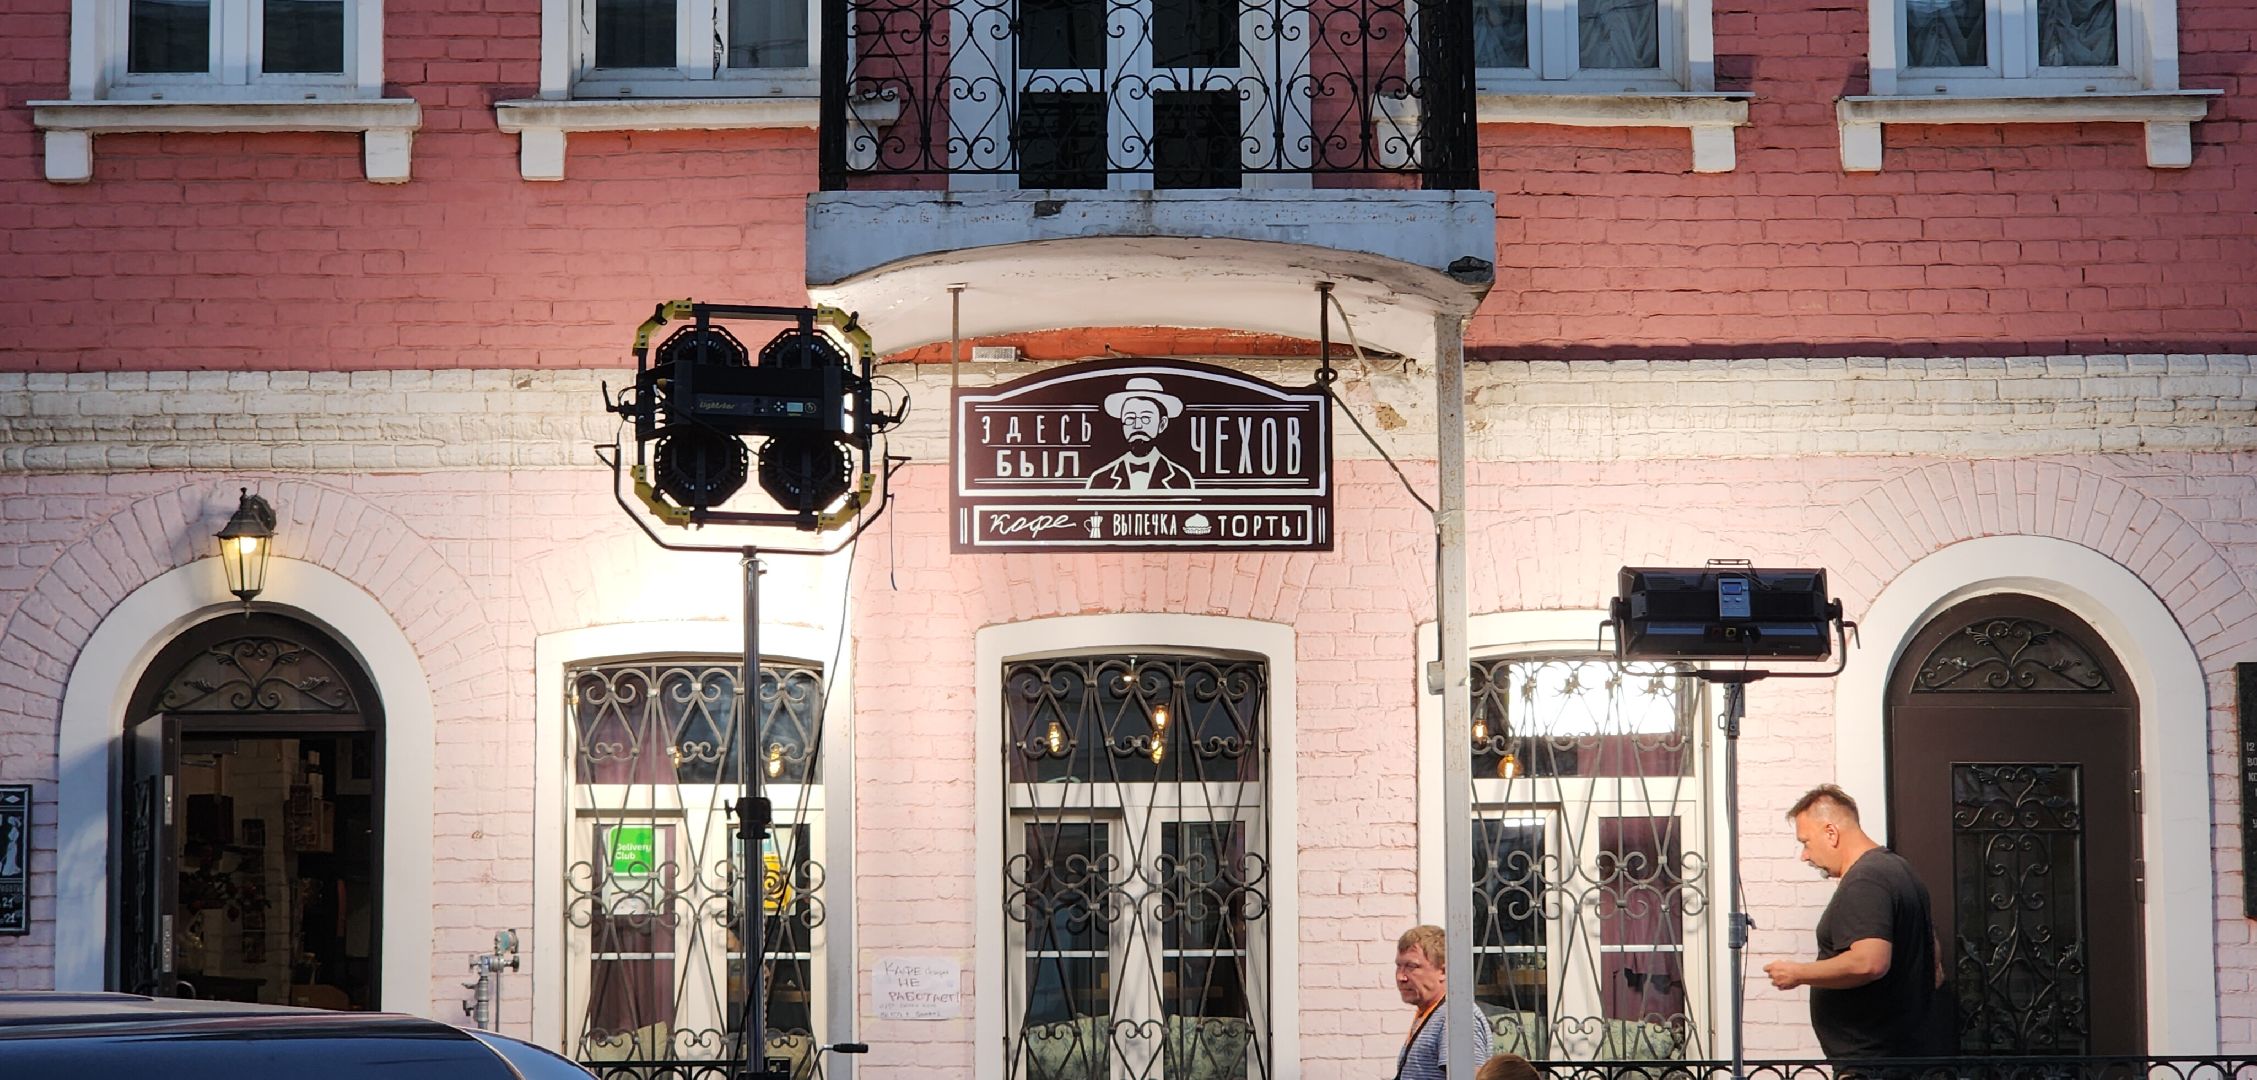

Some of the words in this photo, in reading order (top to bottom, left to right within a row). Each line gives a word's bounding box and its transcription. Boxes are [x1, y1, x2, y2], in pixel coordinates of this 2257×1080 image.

[981, 413, 1093, 444] ЗДЕСЬ
[1190, 415, 1302, 476] ЧЕХОВ
[996, 450, 1080, 477] БЫЛ
[1112, 512, 1177, 536] ВЫПЕЧКА
[1218, 515, 1302, 538] ТОРТЫ
[616, 843, 652, 852] Delivery
[616, 852, 636, 860] Club
[898, 978, 920, 987] НЕ
